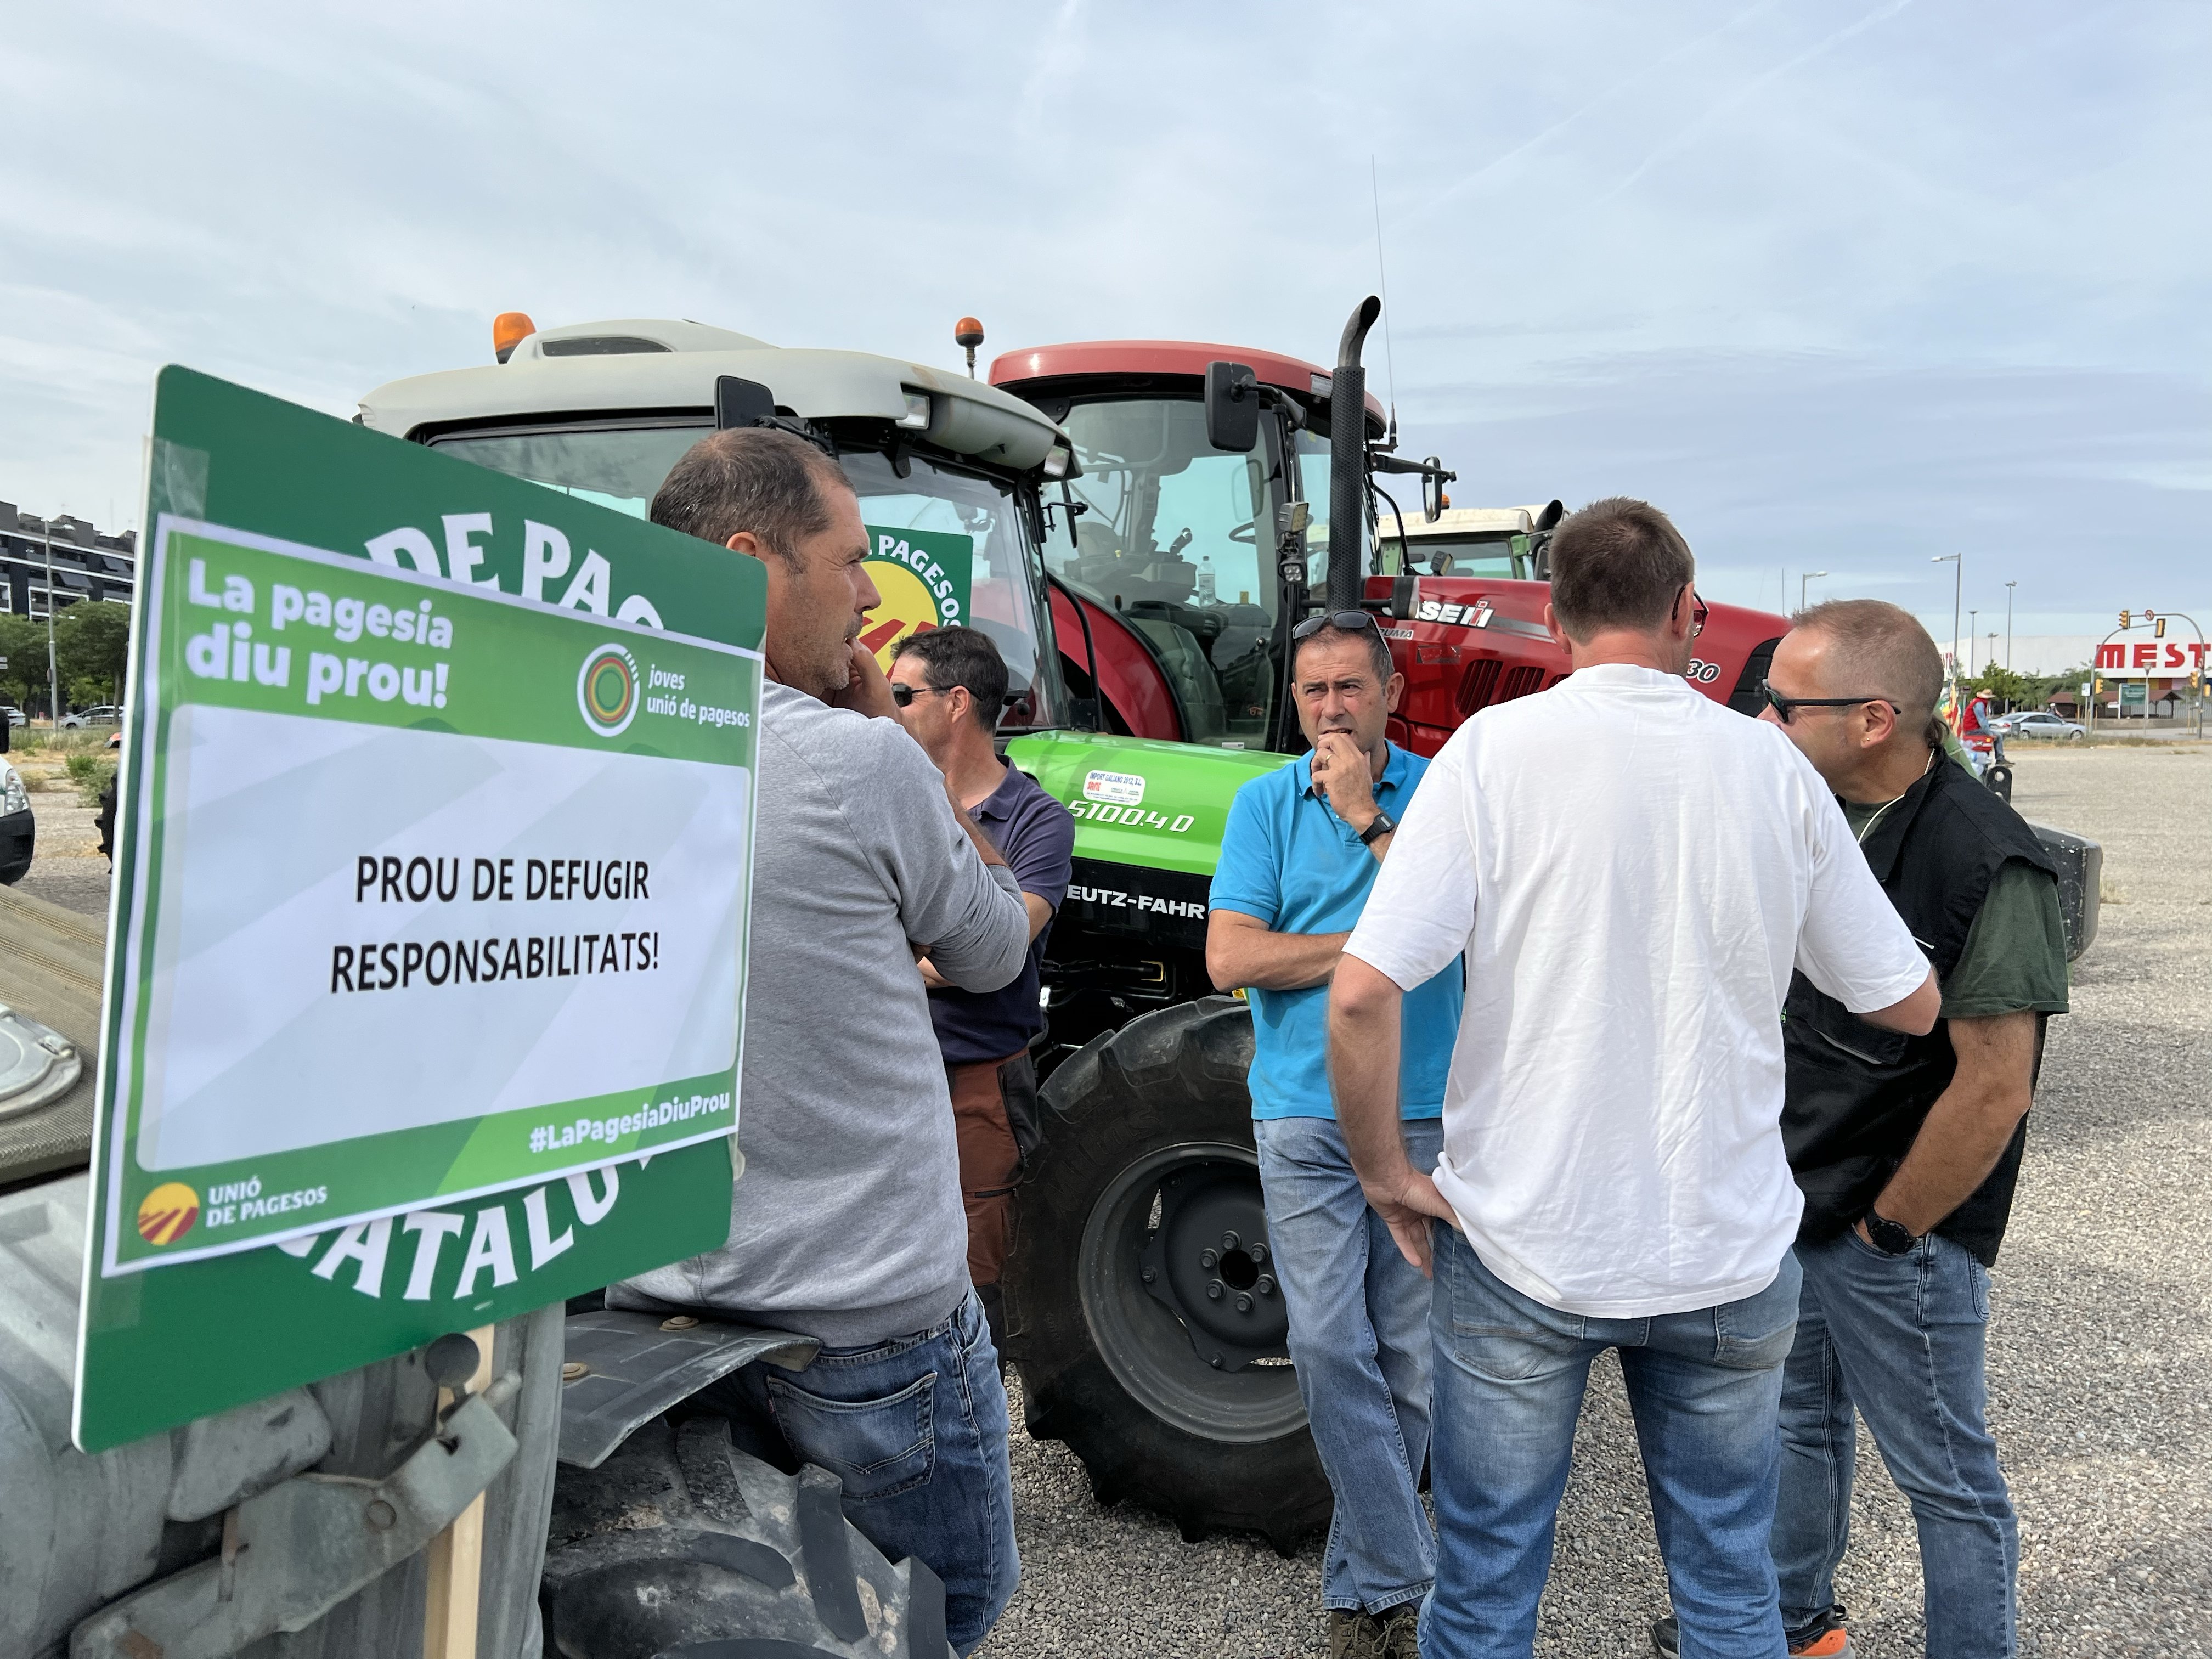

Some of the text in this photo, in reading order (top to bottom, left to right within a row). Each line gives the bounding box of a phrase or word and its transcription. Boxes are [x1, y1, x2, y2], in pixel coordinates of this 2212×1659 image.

[188, 558, 454, 648] La pagesia
[1381, 601, 1463, 624] SE
[185, 621, 449, 709] diu prou!
[648, 664, 686, 691] joves
[1686, 658, 1721, 684] 30
[647, 693, 751, 729] unió de pagesos
[1087, 781, 1101, 791] SAME
[1068, 800, 1168, 830] 5100.4
[357, 856, 650, 902] PROU DE DEFUGIR
[1066, 884, 1205, 919] EUTZ-FAHR
[331, 932, 659, 994] RESPONSABILITATS!
[529, 1091, 730, 1153] #LaPagesiaDiuProu
[206, 1186, 328, 1228] DE PAGESOS
[208, 1175, 261, 1205] UNIÓ
[274, 1154, 654, 1301] ATALU
